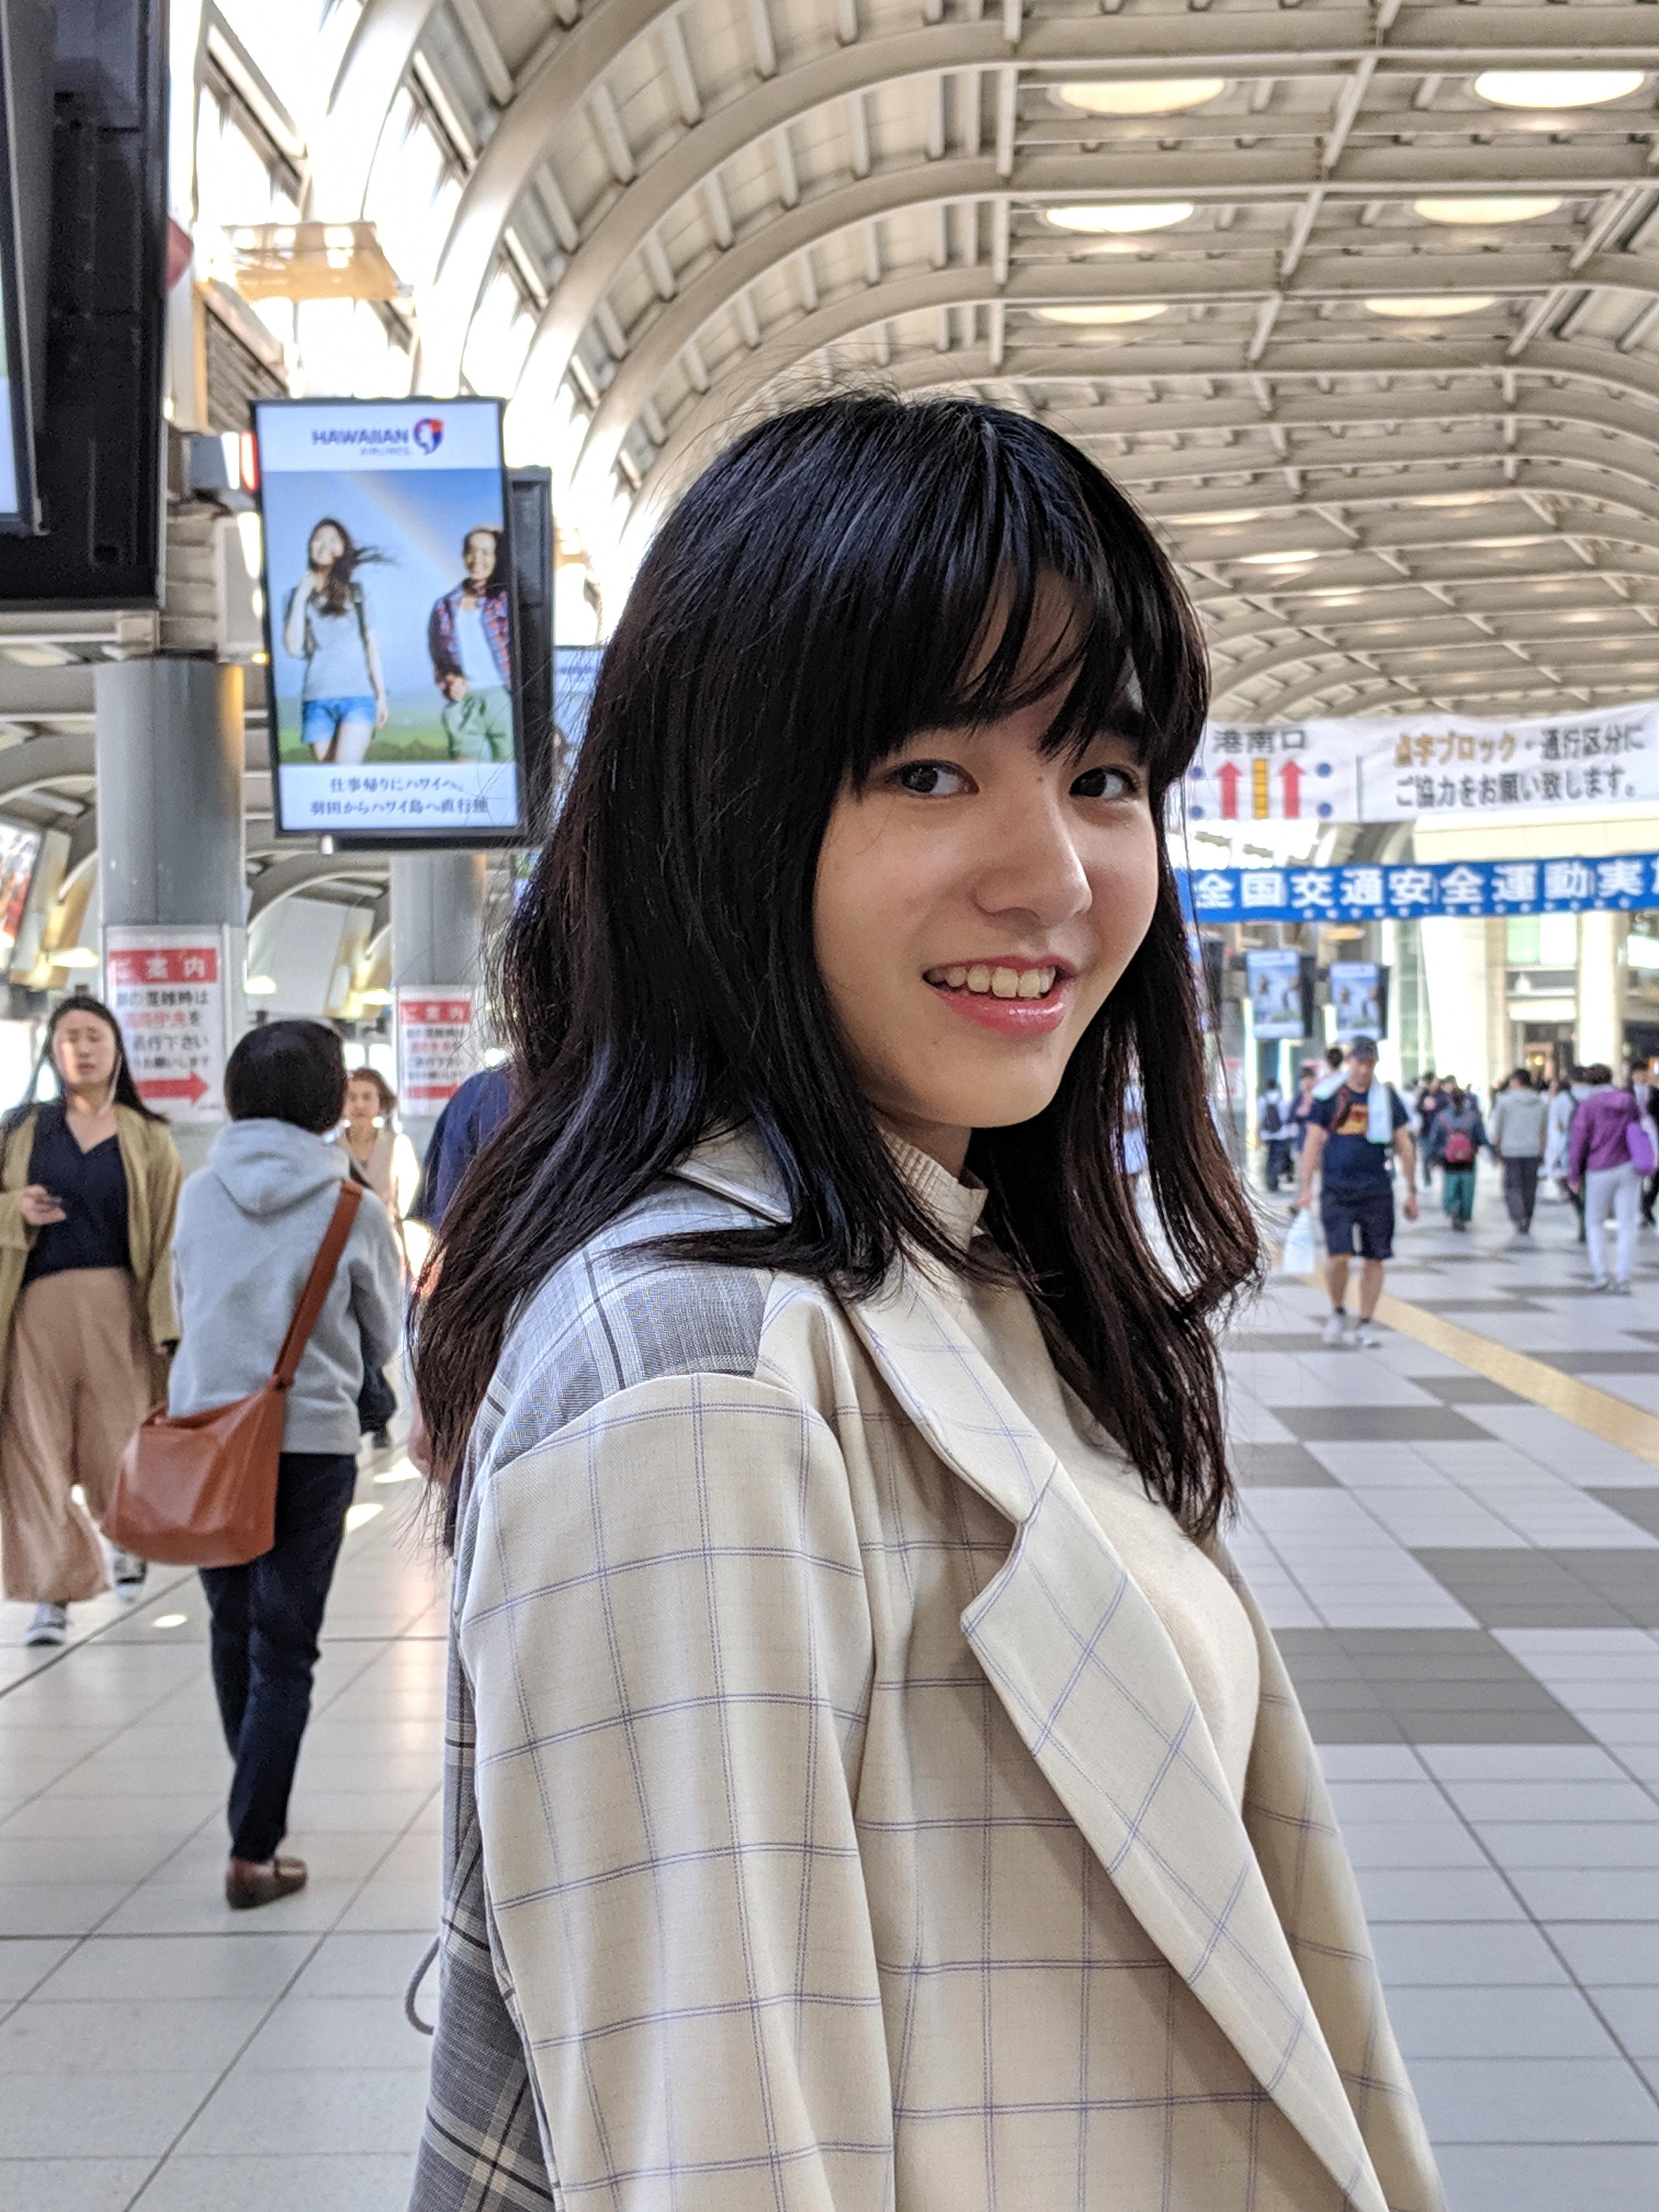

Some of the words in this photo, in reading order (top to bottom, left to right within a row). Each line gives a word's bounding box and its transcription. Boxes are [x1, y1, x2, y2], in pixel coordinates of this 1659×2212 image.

[312, 428, 410, 445] HAWAIIAN
[1212, 728, 1305, 754] 港南口
[1396, 764, 1636, 808] ご協力をお願い致します。
[1193, 855, 1659, 909] 全国交通安全運動実
